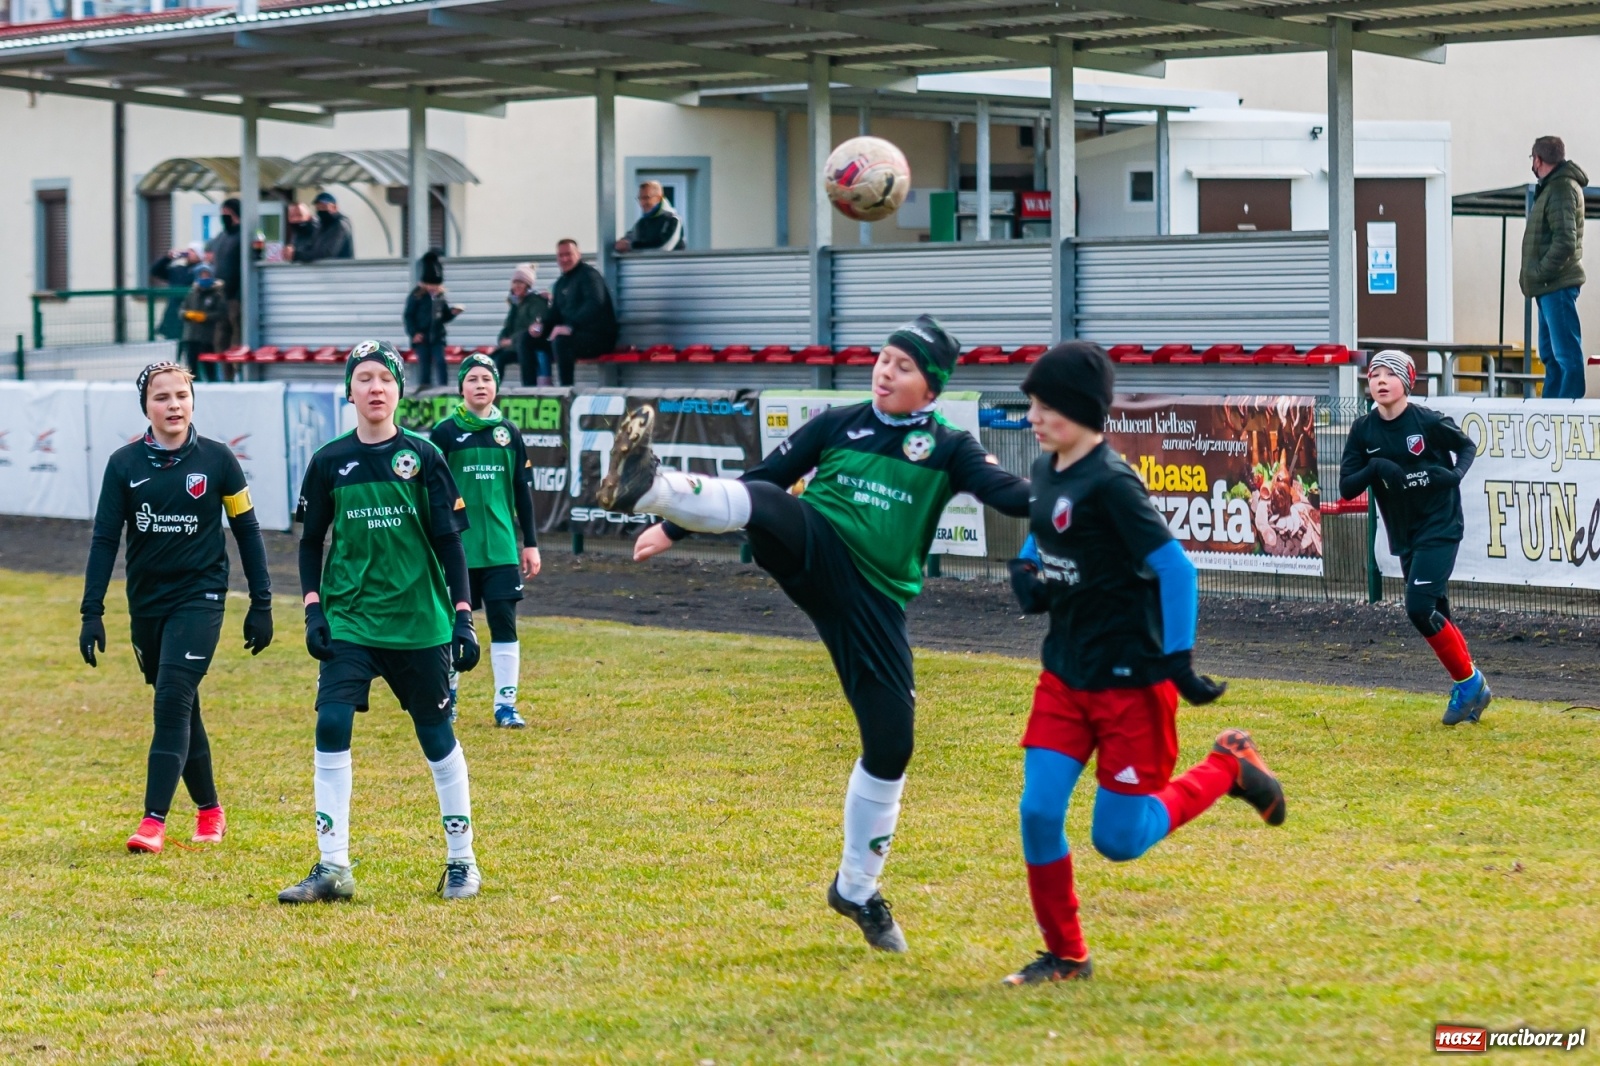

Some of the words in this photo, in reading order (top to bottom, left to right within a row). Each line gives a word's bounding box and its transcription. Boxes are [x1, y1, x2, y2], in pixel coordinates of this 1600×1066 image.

[1103, 412, 1152, 434] Producent
[462, 464, 505, 473] RESTURACJA
[1120, 453, 1208, 492] łbasa
[837, 474, 913, 504] RESTAURACJA
[853, 491, 891, 511] BRAVO
[157, 515, 199, 523] FUNDACJA
[346, 504, 418, 519] RESTAURACJA
[152, 523, 182, 533] Brawo
[183, 523, 198, 535] Ty!
[367, 517, 402, 529] BRAVO
[935, 525, 978, 542] ERAKOLL
